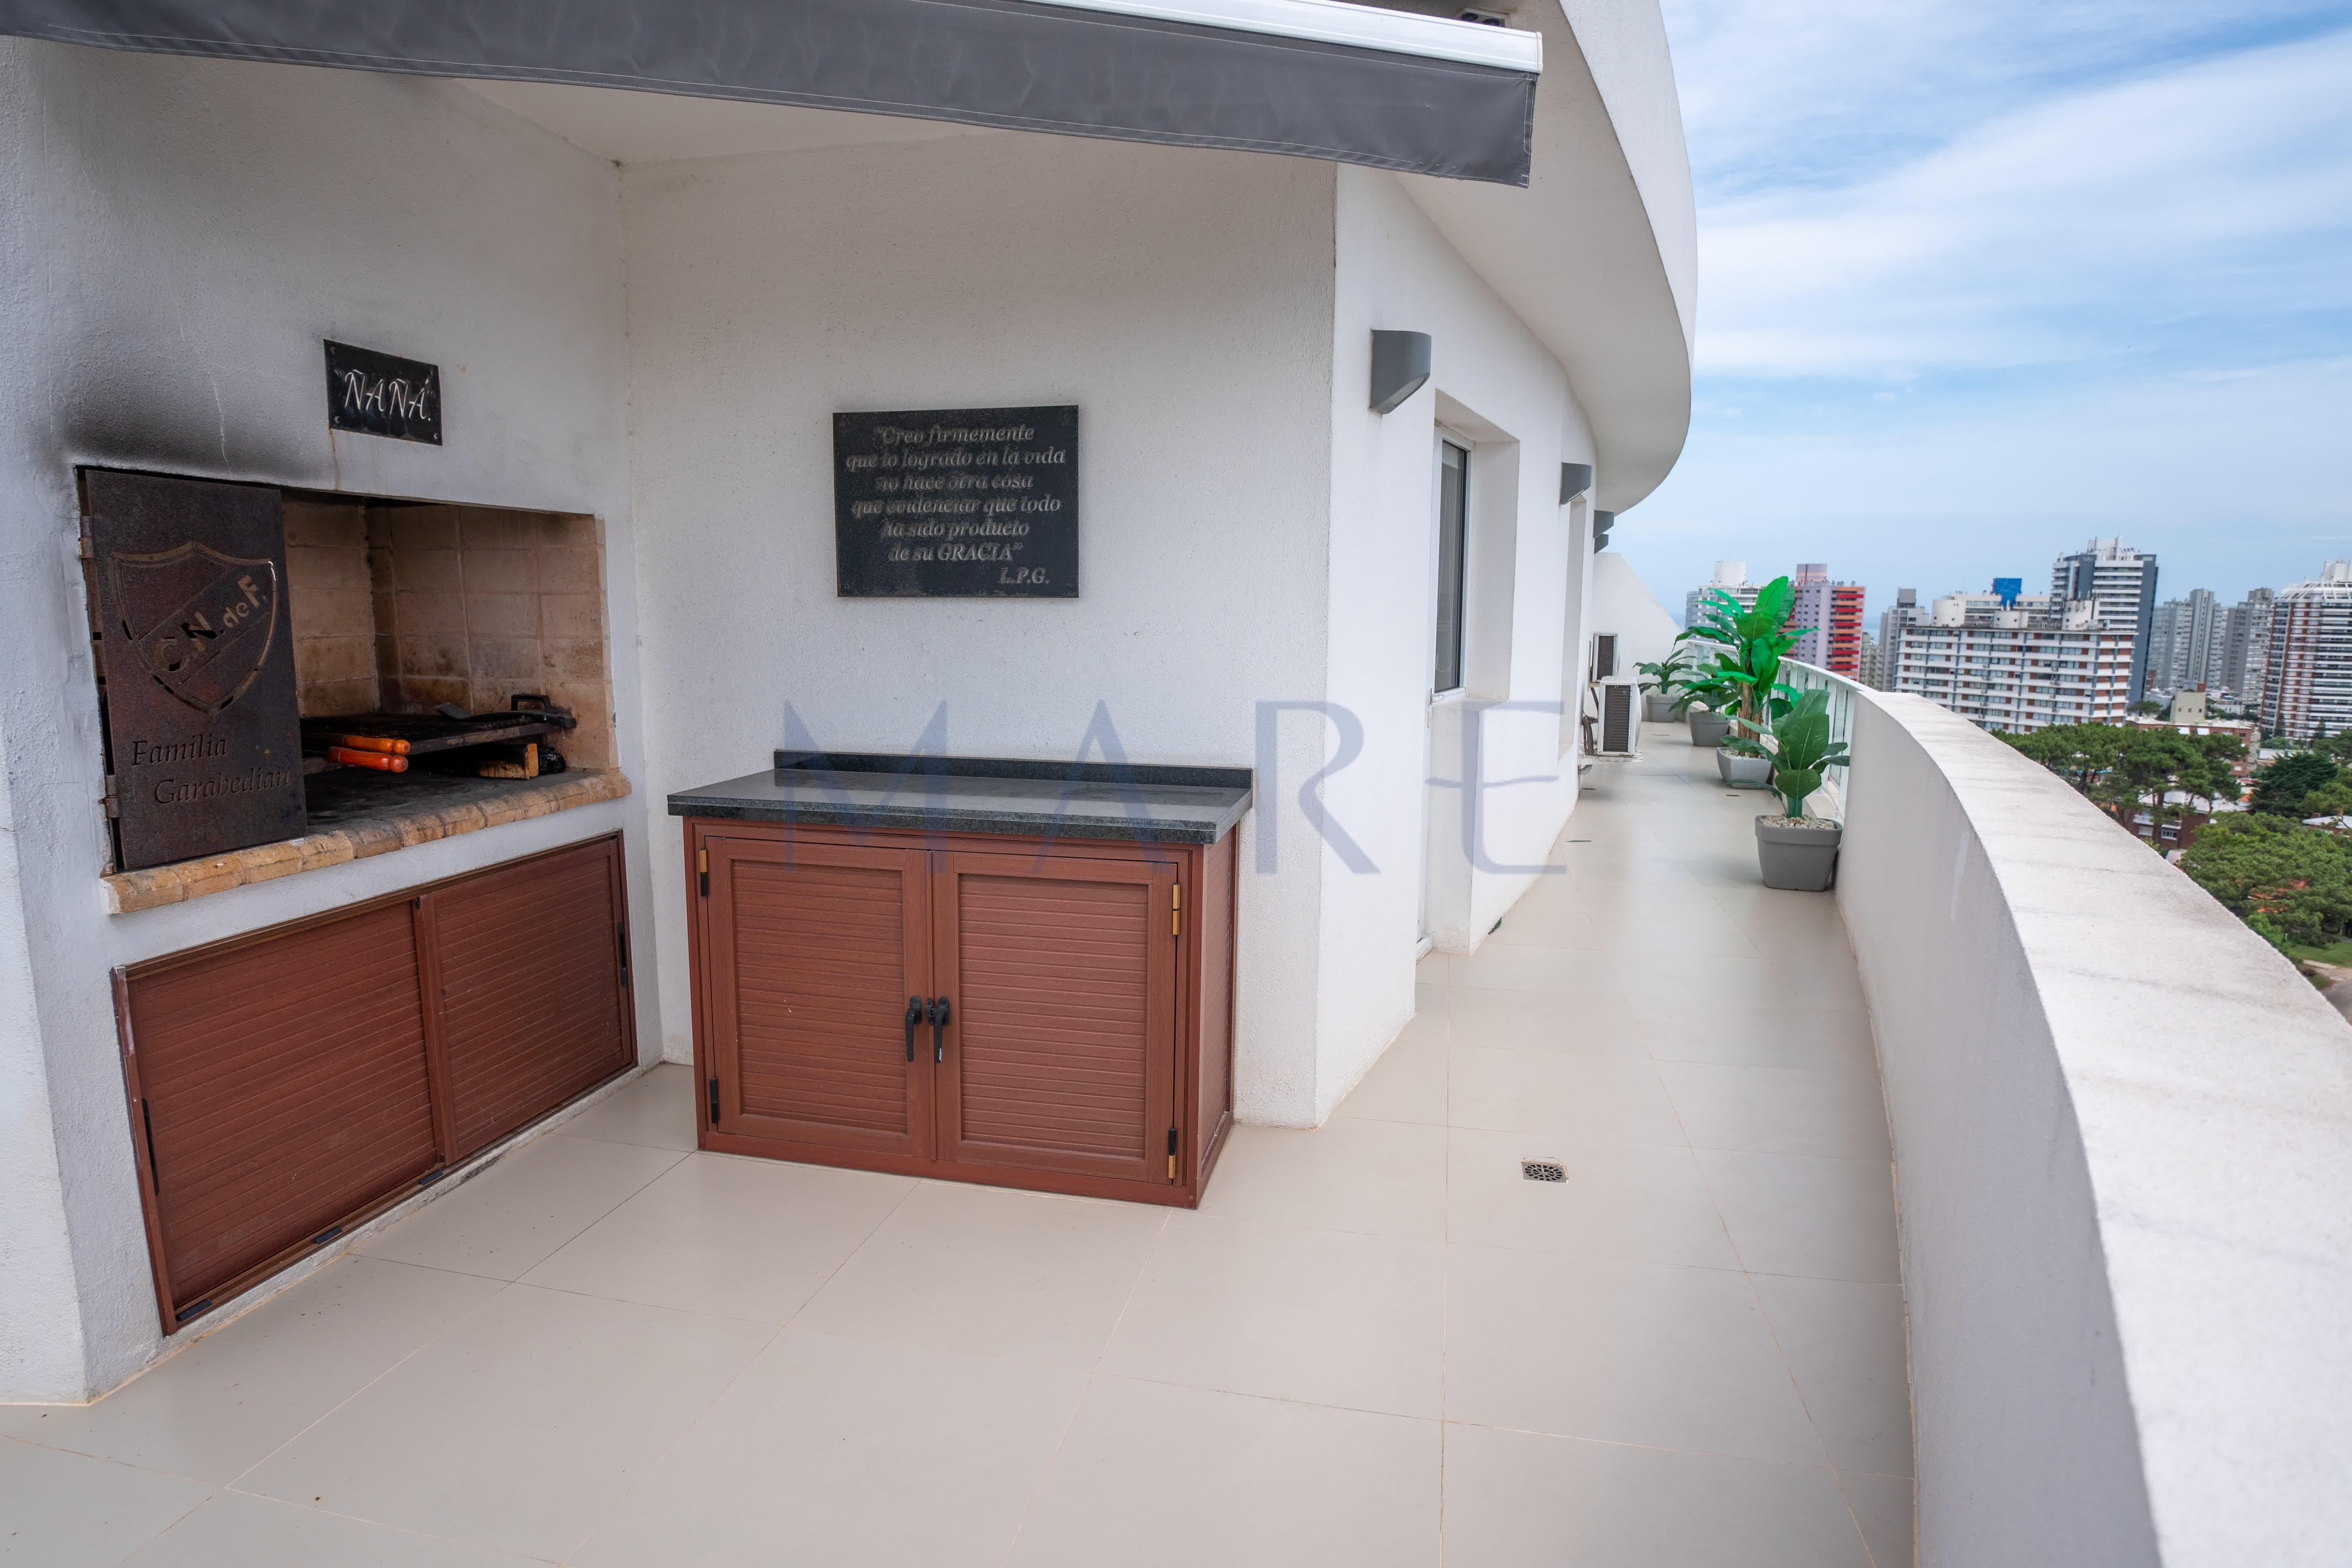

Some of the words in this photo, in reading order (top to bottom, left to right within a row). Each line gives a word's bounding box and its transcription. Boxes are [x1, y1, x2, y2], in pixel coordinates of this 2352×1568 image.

[927, 425, 1035, 446] firmemente
[846, 453, 877, 472] que
[881, 449, 898, 466] lo
[902, 447, 973, 470] logrado
[976, 452, 998, 465] en
[1001, 446, 1020, 465] la
[1024, 446, 1065, 464] vida
[875, 476, 899, 490] no
[903, 473, 944, 490] hace
[946, 474, 988, 489] otra
[991, 474, 1033, 489] cosa
[852, 499, 883, 519] que
[886, 496, 981, 513] evidenciar
[982, 499, 1017, 517] que
[1020, 493, 1061, 513] todo
[881, 518, 904, 538] ha
[907, 518, 946, 537] sido
[948, 517, 1031, 540] producto
[888, 541, 909, 561] de
[913, 547, 934, 561] su
[998, 567, 1050, 584] L.P.G.
[130, 734, 227, 766] Familia
[154, 767, 289, 804] Garabedian
